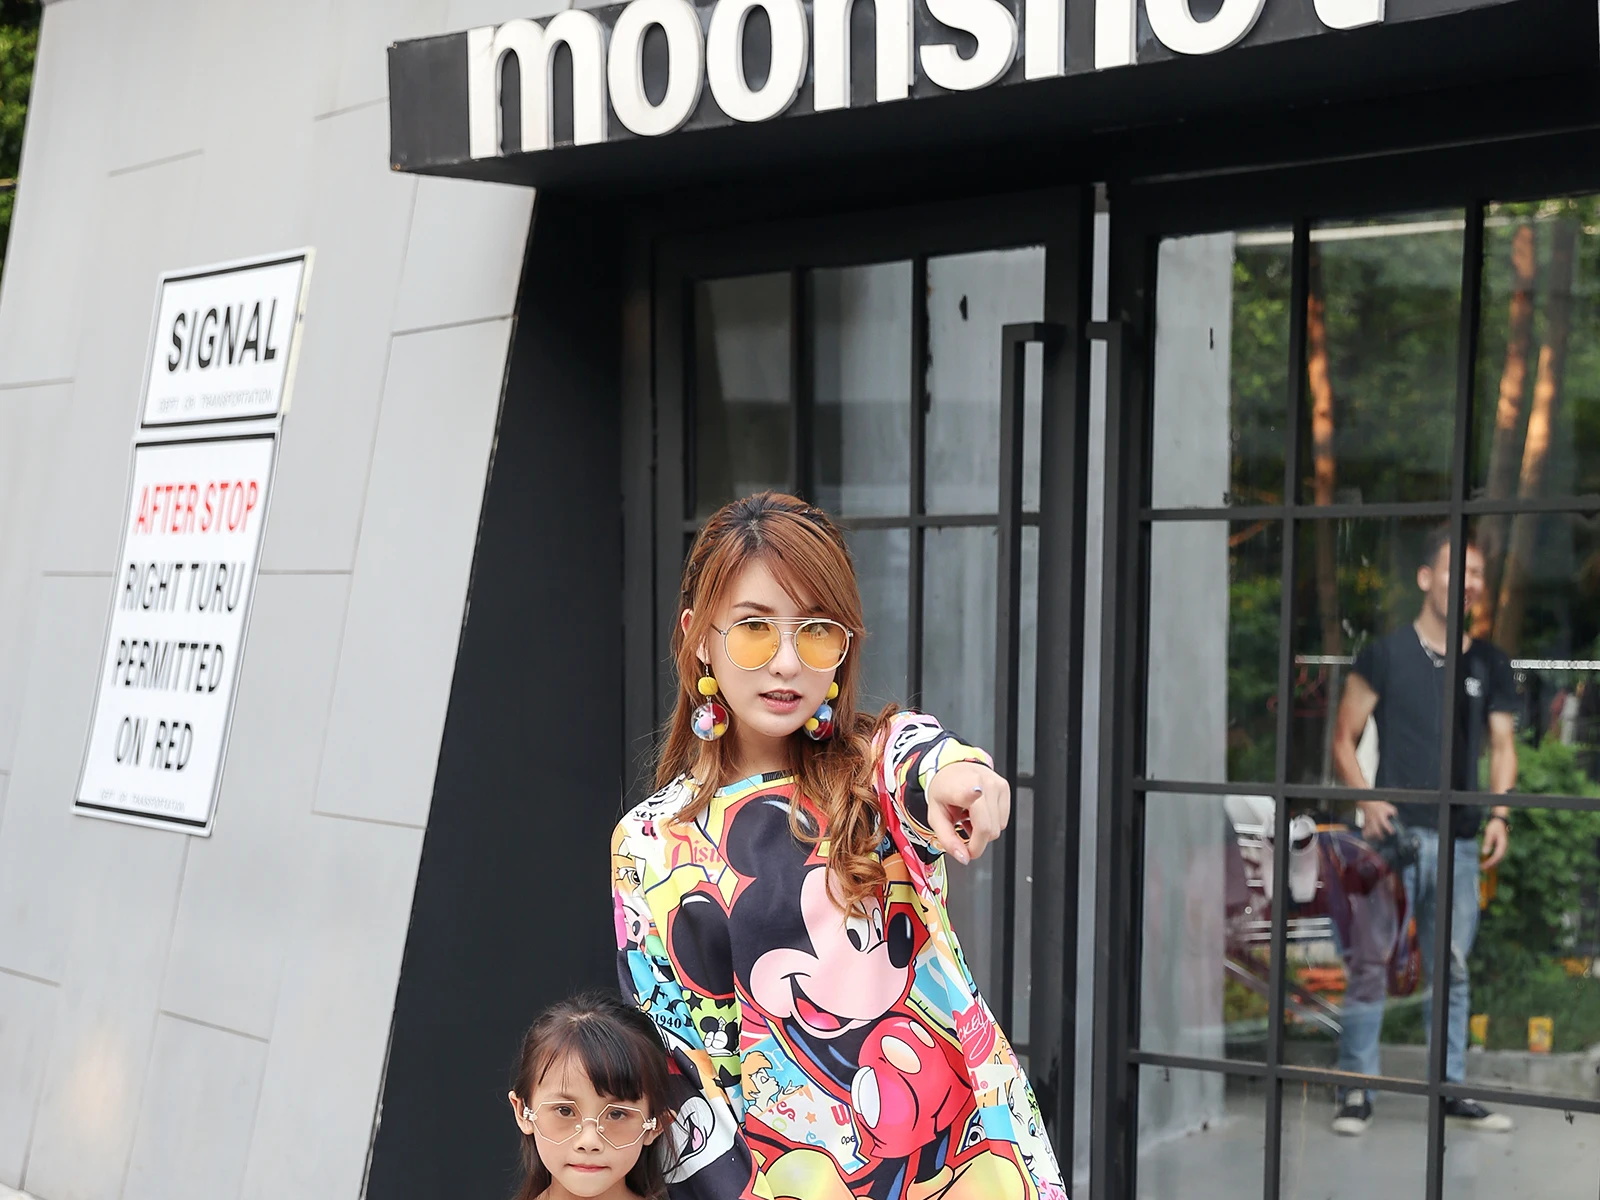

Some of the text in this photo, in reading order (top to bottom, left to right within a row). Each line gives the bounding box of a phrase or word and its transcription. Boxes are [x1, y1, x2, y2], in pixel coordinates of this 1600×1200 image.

[467, 0, 1385, 159] moons
[168, 297, 276, 372] SIGNAL
[133, 481, 259, 534] AFTER STOP
[120, 562, 185, 613] RIGHT
[111, 638, 225, 693] PERMITTED
[114, 716, 194, 772] ON RED
[655, 1013, 682, 1029] 1940
